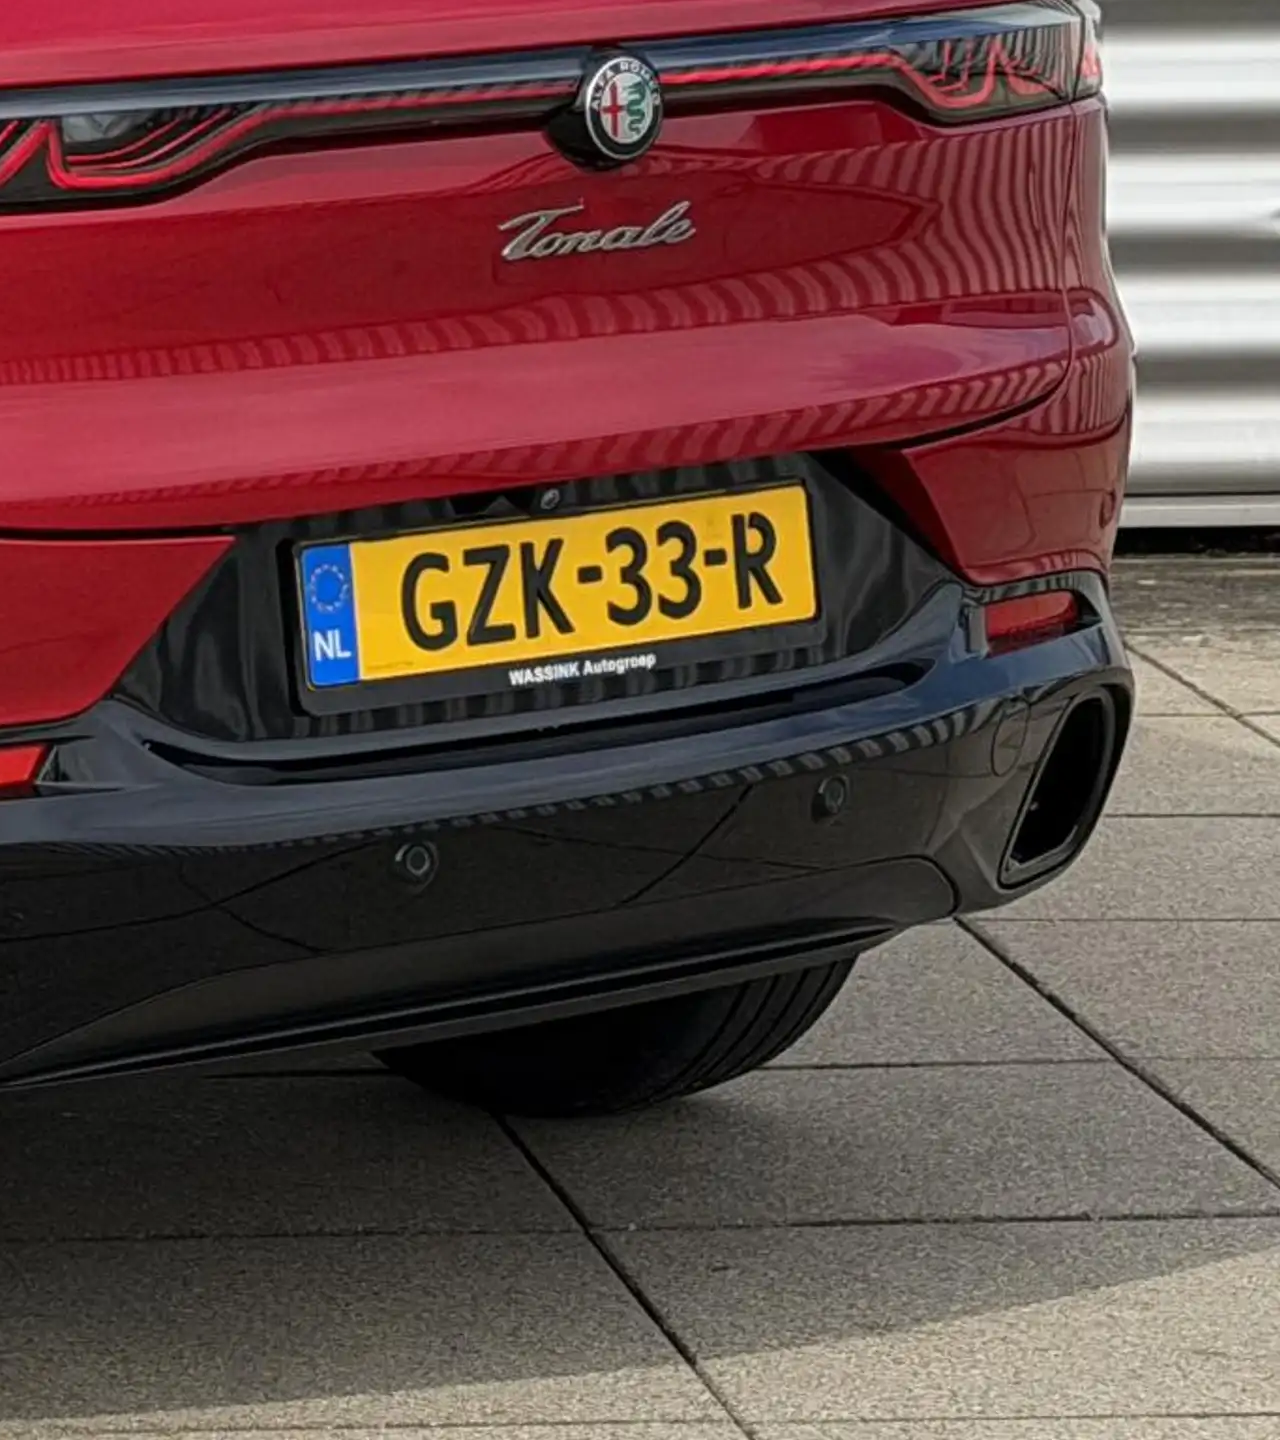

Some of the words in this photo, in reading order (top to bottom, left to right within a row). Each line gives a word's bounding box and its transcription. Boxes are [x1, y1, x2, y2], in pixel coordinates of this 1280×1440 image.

[497, 201, 696, 261] Tonale
[401, 511, 783, 651] GZK-33-R
[313, 627, 352, 661] NL
[508, 661, 580, 686] WASSINK
